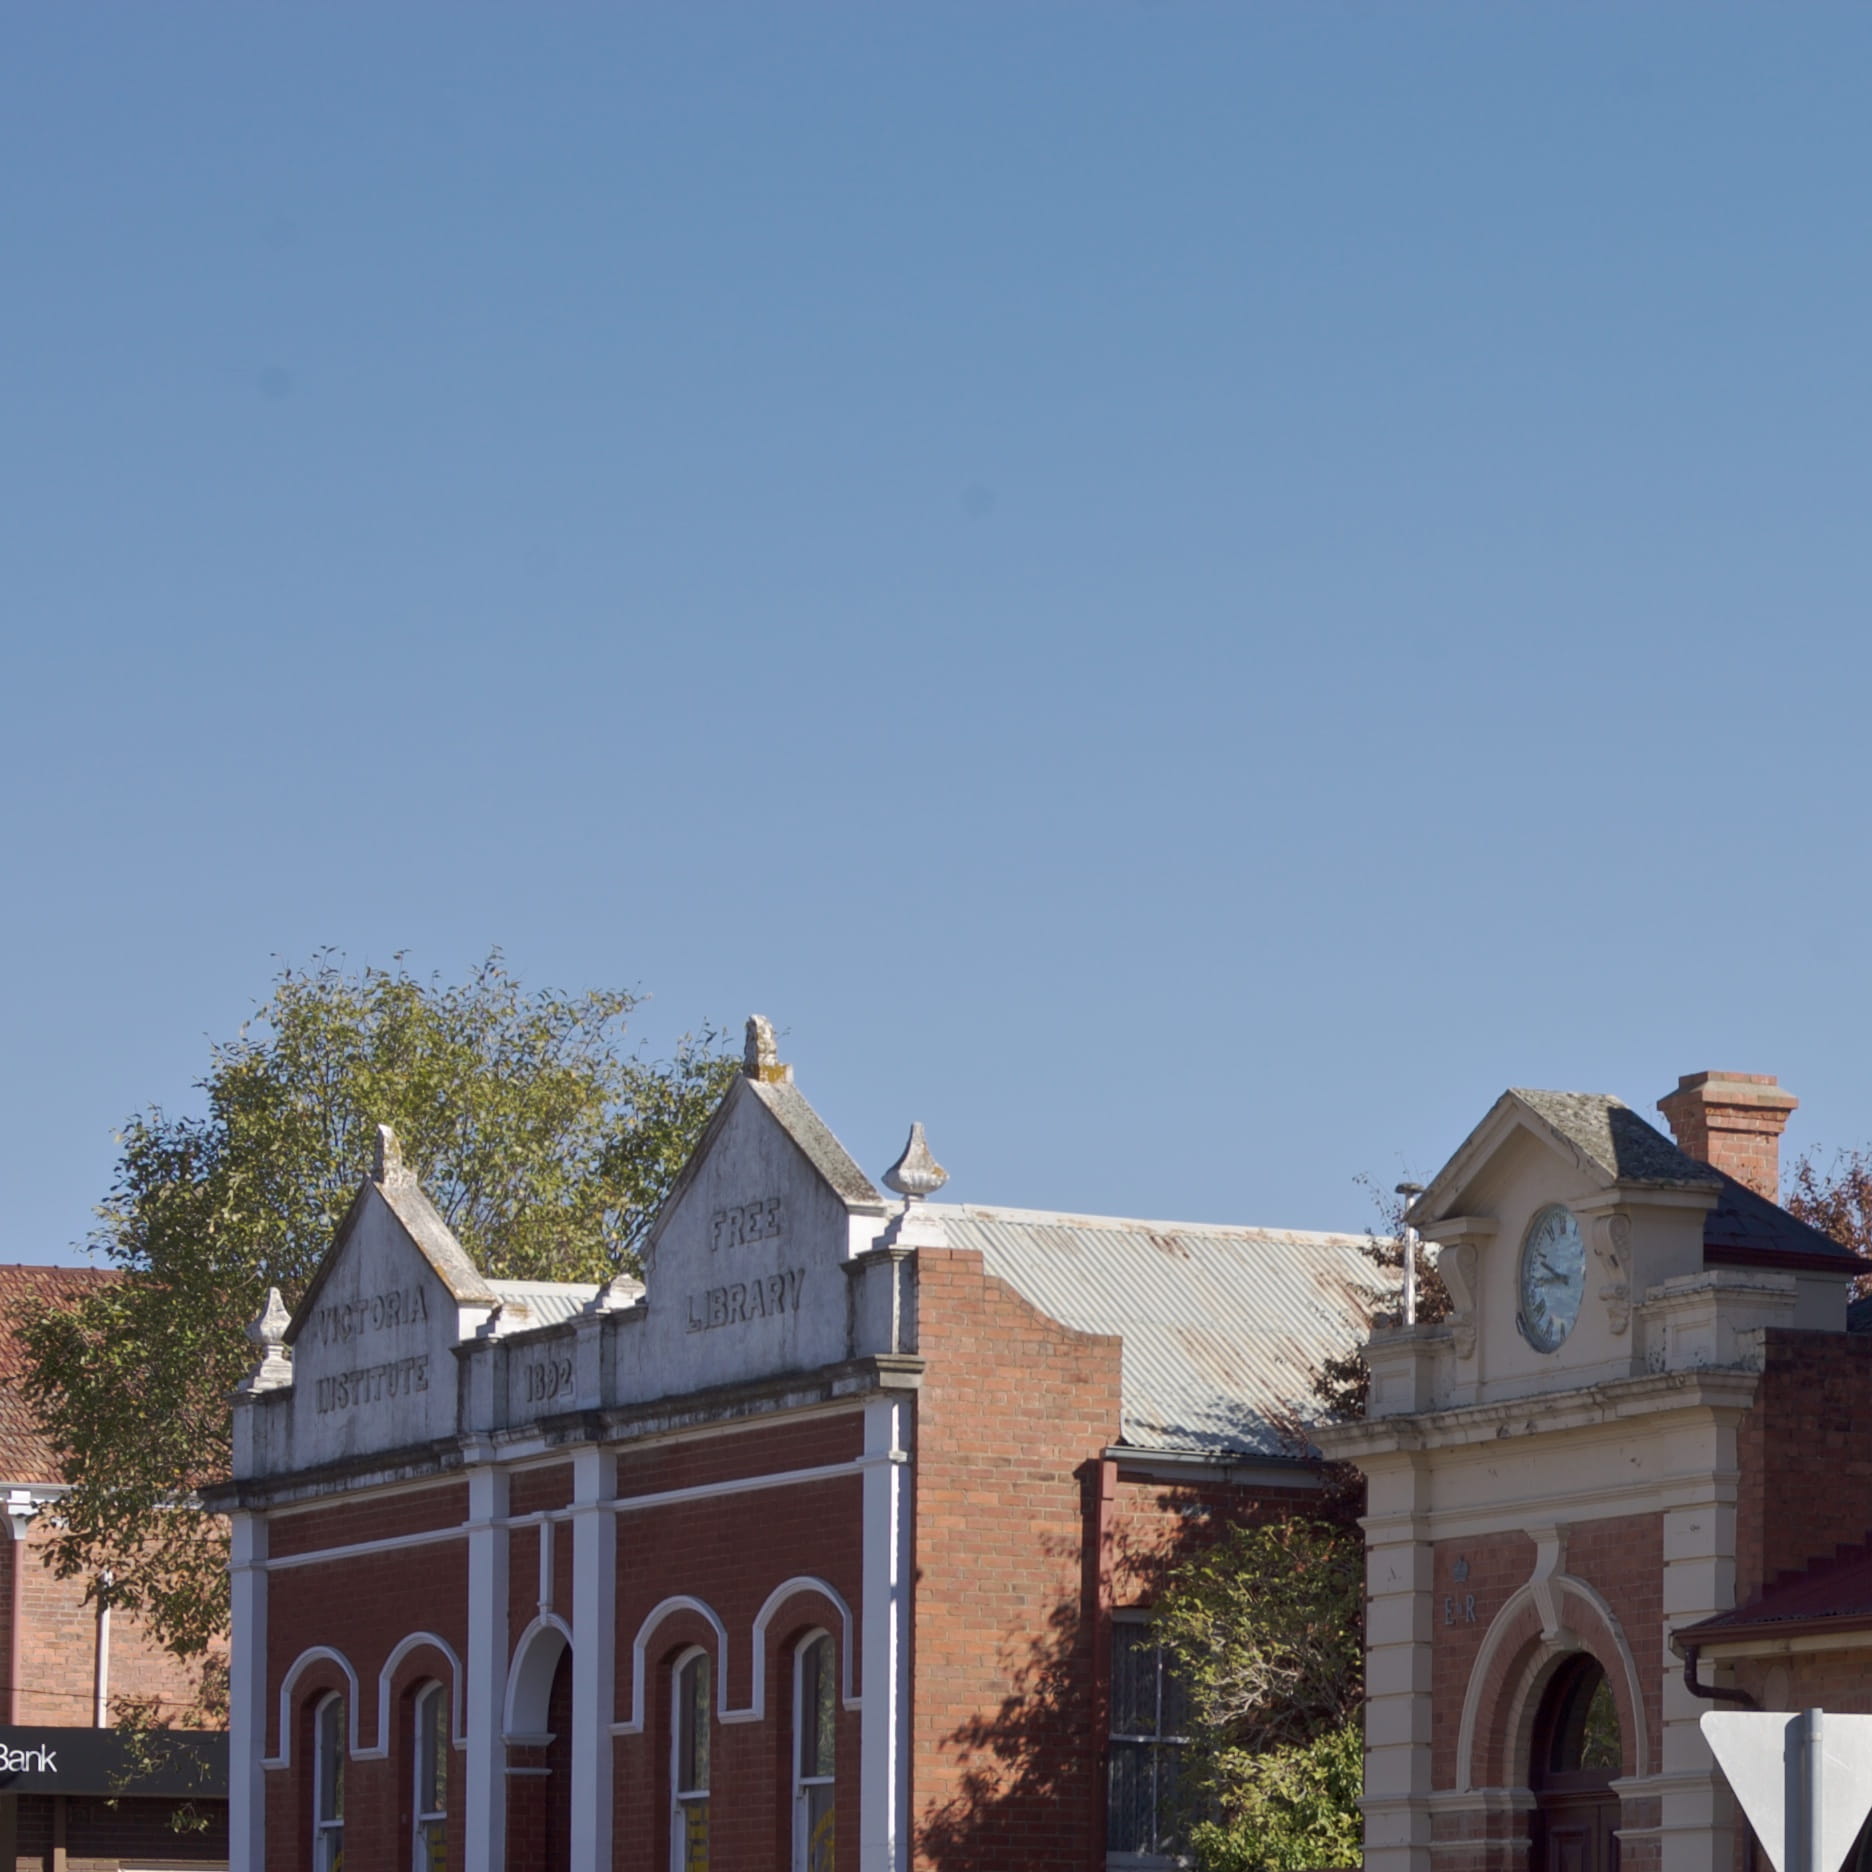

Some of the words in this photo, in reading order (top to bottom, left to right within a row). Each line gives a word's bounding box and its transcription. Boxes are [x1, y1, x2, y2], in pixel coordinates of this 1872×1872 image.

[711, 1197, 781, 1252] FREE
[319, 1283, 428, 1345] VICTORIA
[686, 1267, 806, 1334] LIBRARY
[316, 1353, 429, 1414] INSTITUTE
[525, 1358, 574, 1403] 1892
